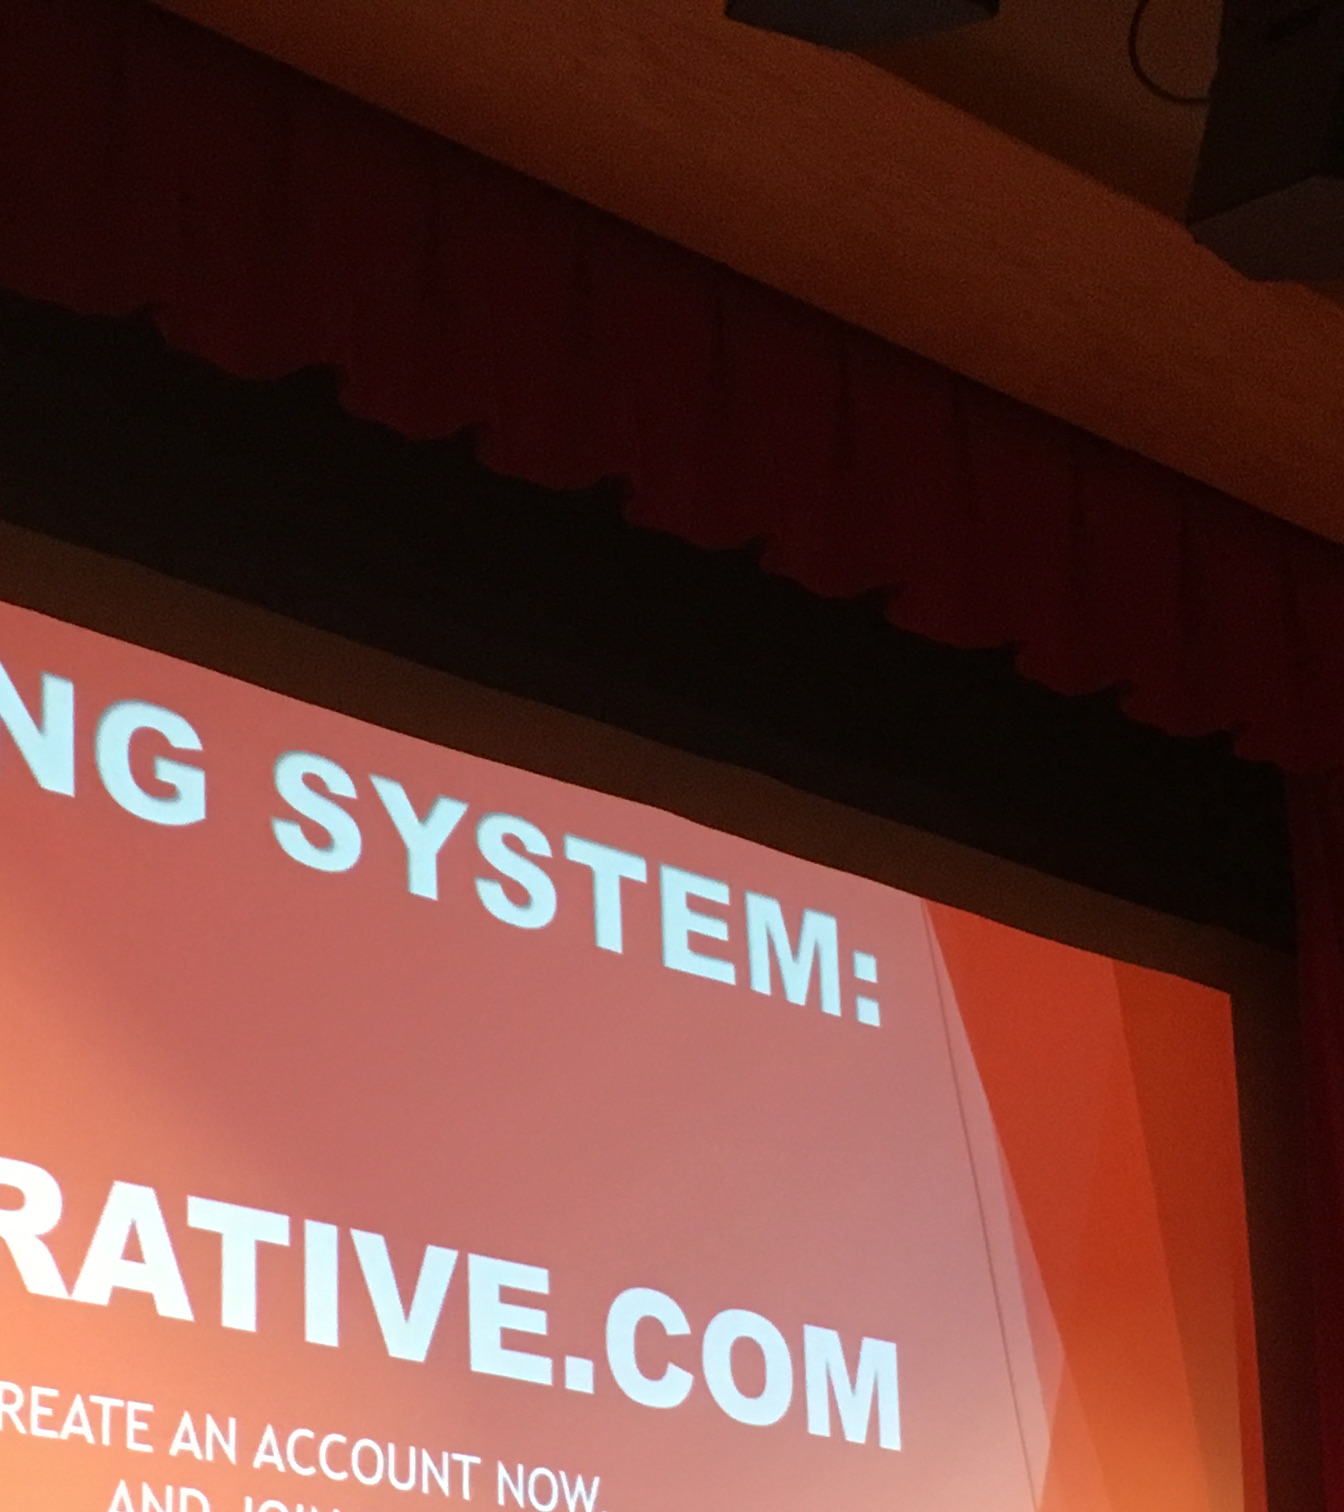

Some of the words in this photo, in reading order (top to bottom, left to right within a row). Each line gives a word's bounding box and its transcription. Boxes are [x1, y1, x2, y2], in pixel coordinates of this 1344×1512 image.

[271, 750, 881, 1027] SYSTEM:
[169, 1411, 237, 1465] AN
[253, 1424, 481, 1501] ACCOUNT
